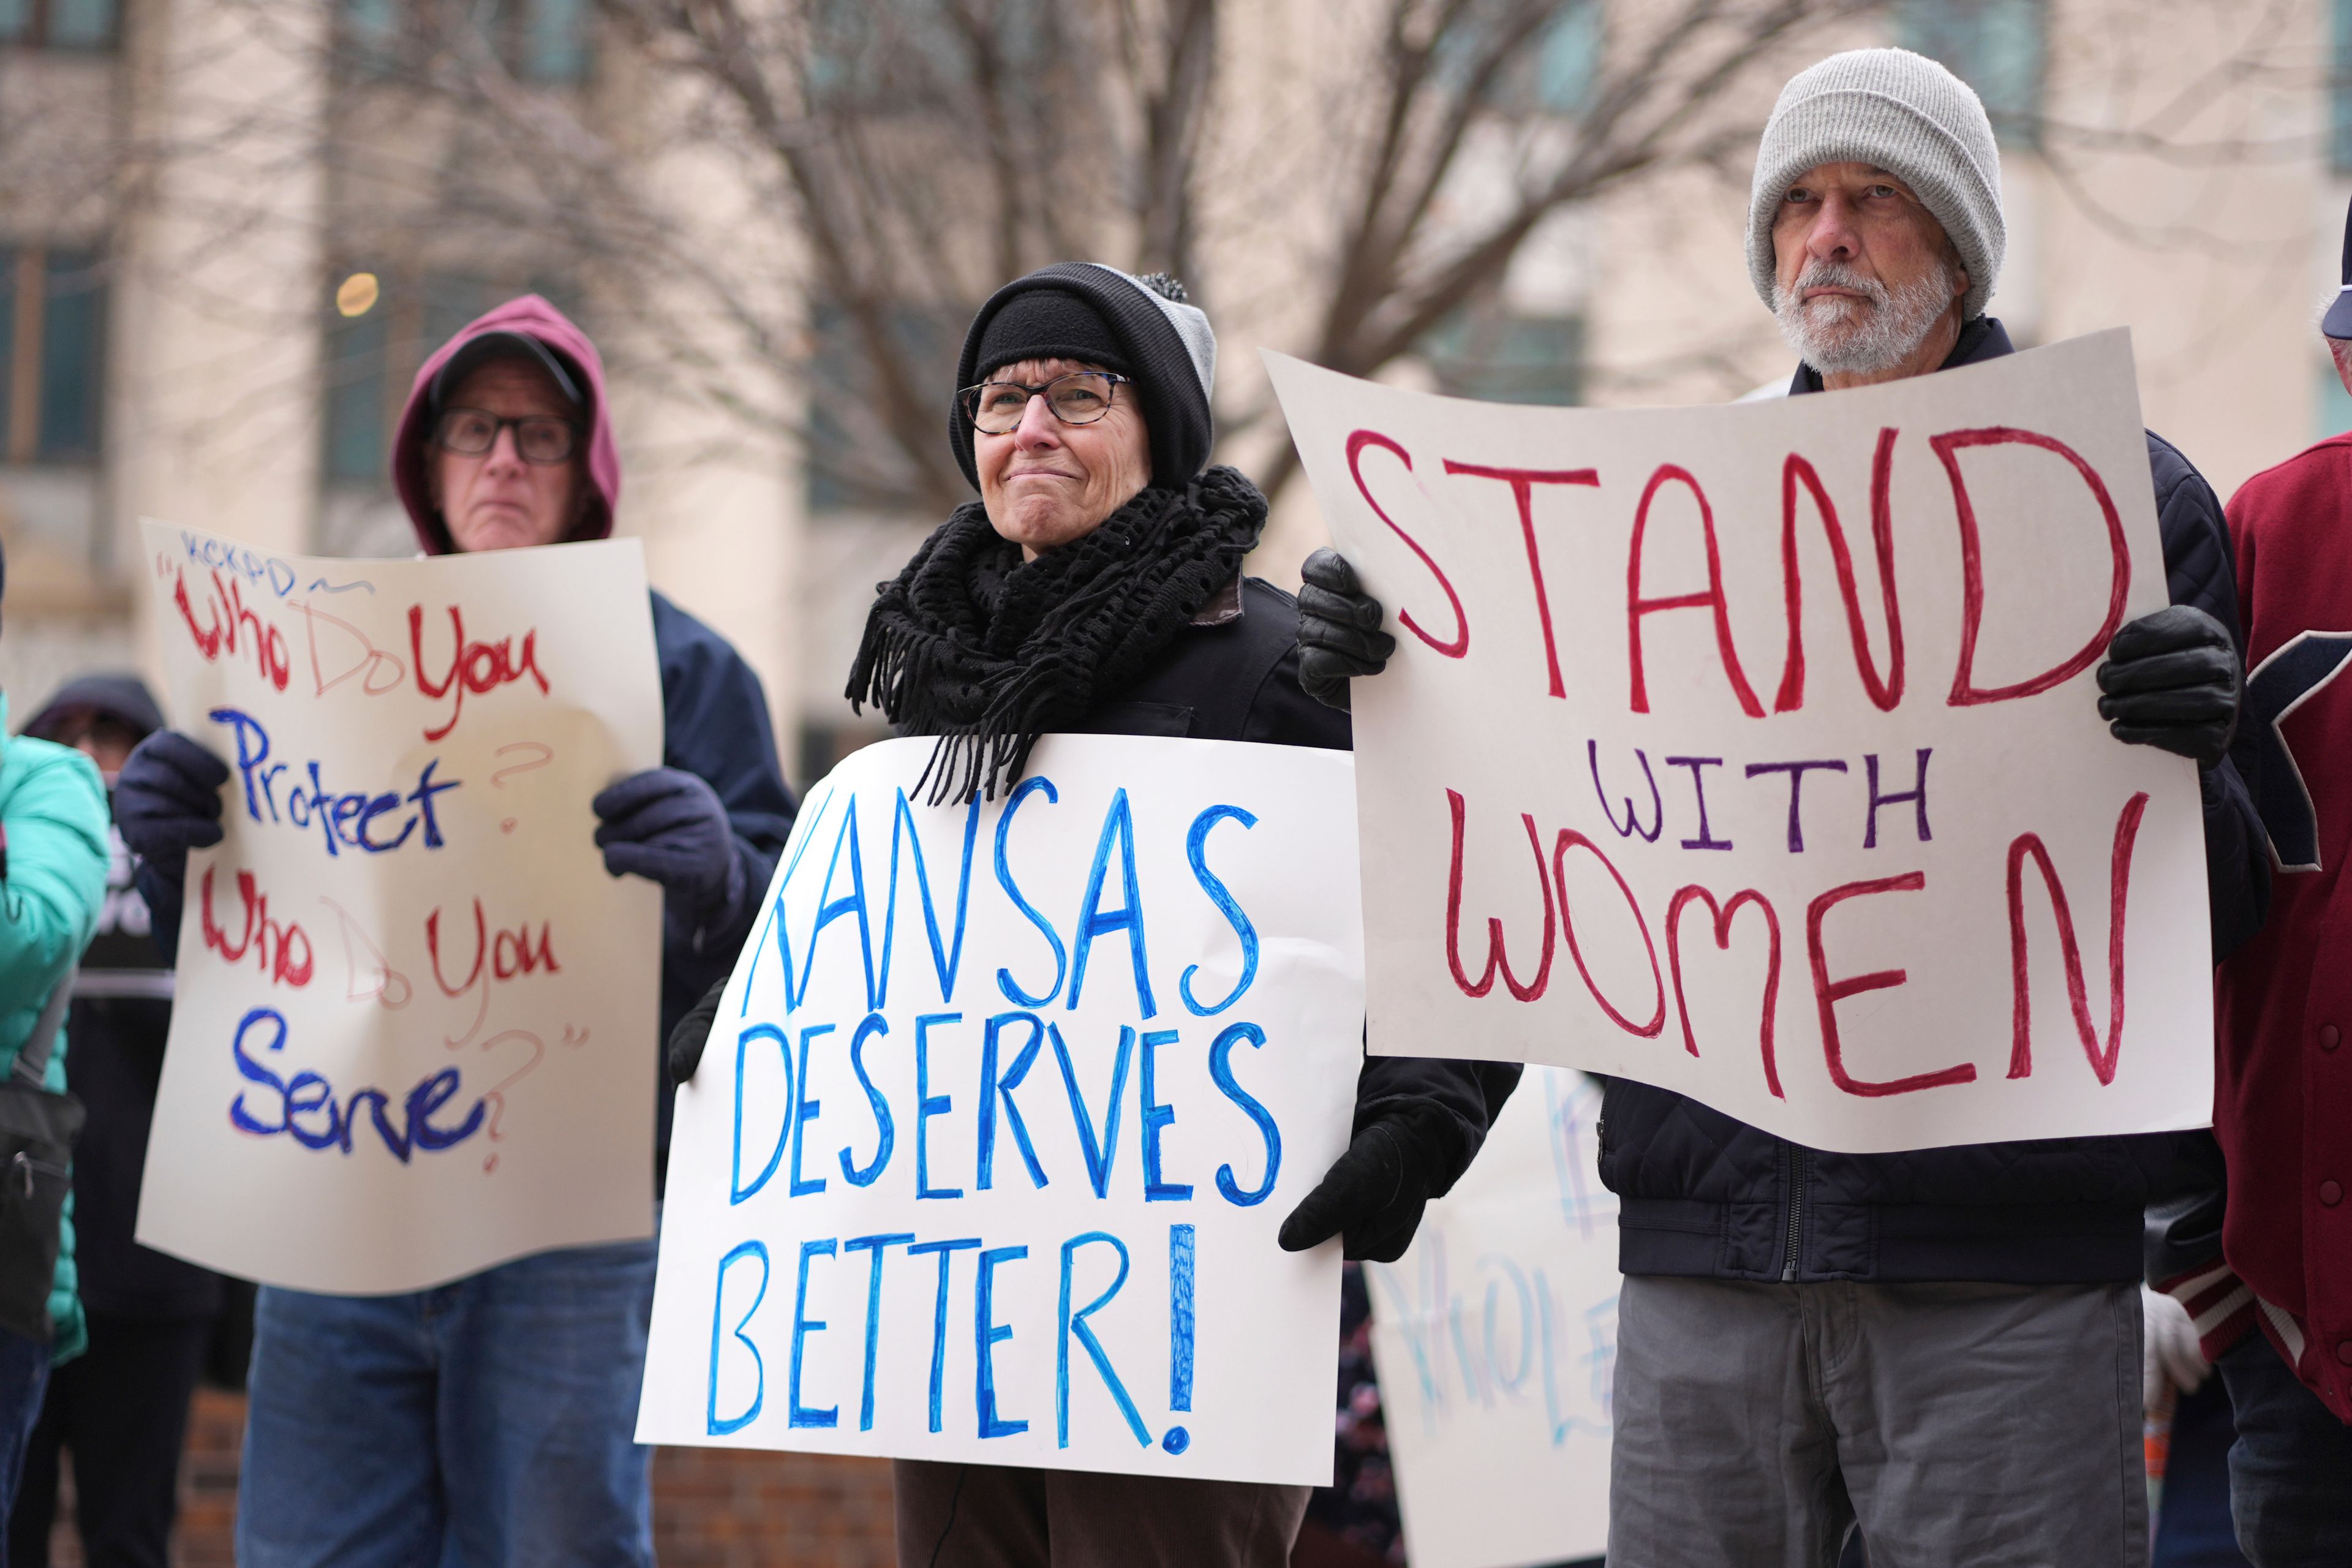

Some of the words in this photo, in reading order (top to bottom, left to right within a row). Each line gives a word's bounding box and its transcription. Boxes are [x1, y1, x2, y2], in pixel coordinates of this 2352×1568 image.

[287, 600, 405, 697] Do
[407, 603, 550, 743] You
[1347, 426, 2130, 718] STAND
[742, 775, 1259, 1019] KANSAS
[1588, 740, 1933, 853] WITH
[202, 864, 315, 987] Who
[424, 896, 562, 1050] You
[1446, 791, 2150, 1102] WOMEN
[729, 1011, 1282, 1207] DESERVES
[706, 1224, 1196, 1455] BETTER!
